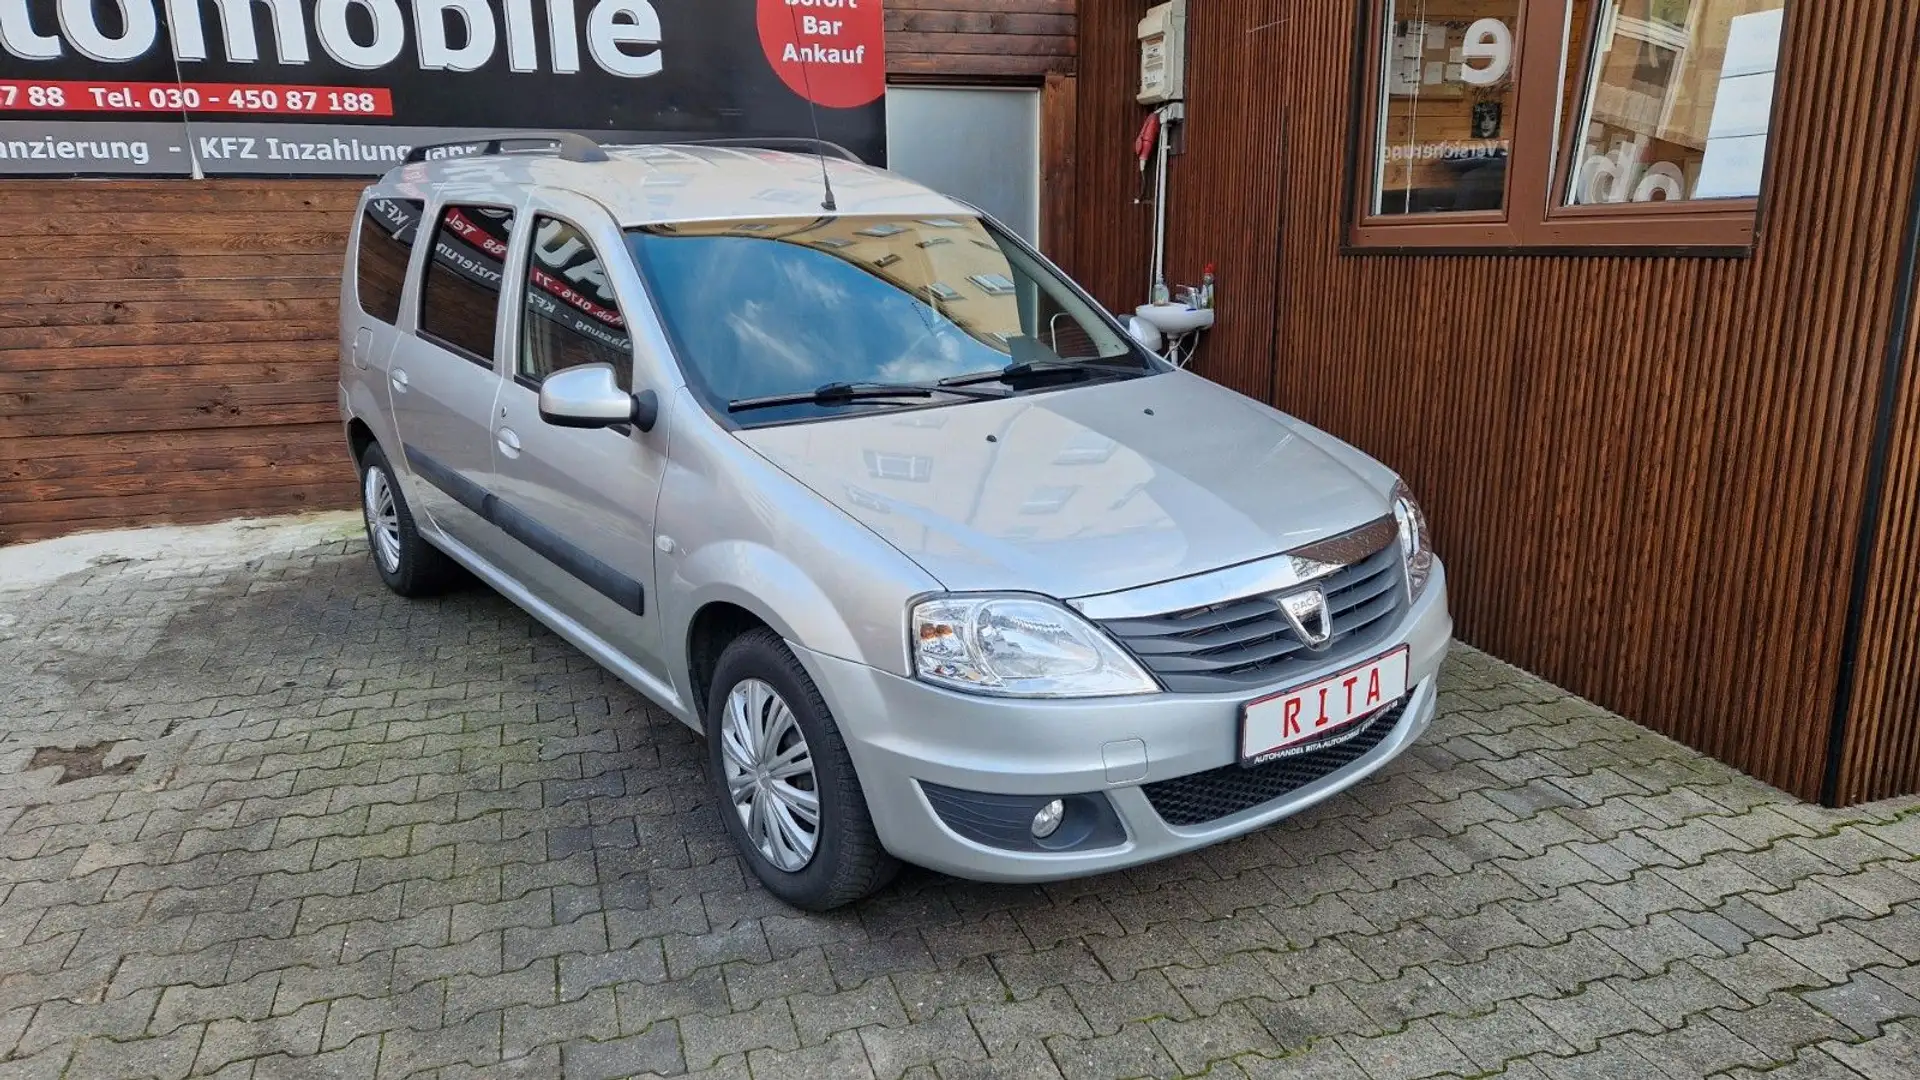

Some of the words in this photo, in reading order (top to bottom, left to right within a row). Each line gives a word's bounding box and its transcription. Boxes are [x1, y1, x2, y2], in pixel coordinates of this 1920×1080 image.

[802, 15, 843, 35] Bar
[782, 43, 865, 64] Ankauf
[27, 86, 65, 107] 88
[88, 87, 141, 108] Tel.
[149, 88, 200, 108] 030
[228, 89, 278, 110] 450
[286, 91, 317, 111] 87
[328, 92, 375, 113] 188
[200, 137, 258, 160] KFZ
[1283, 667, 1380, 738] RITA
